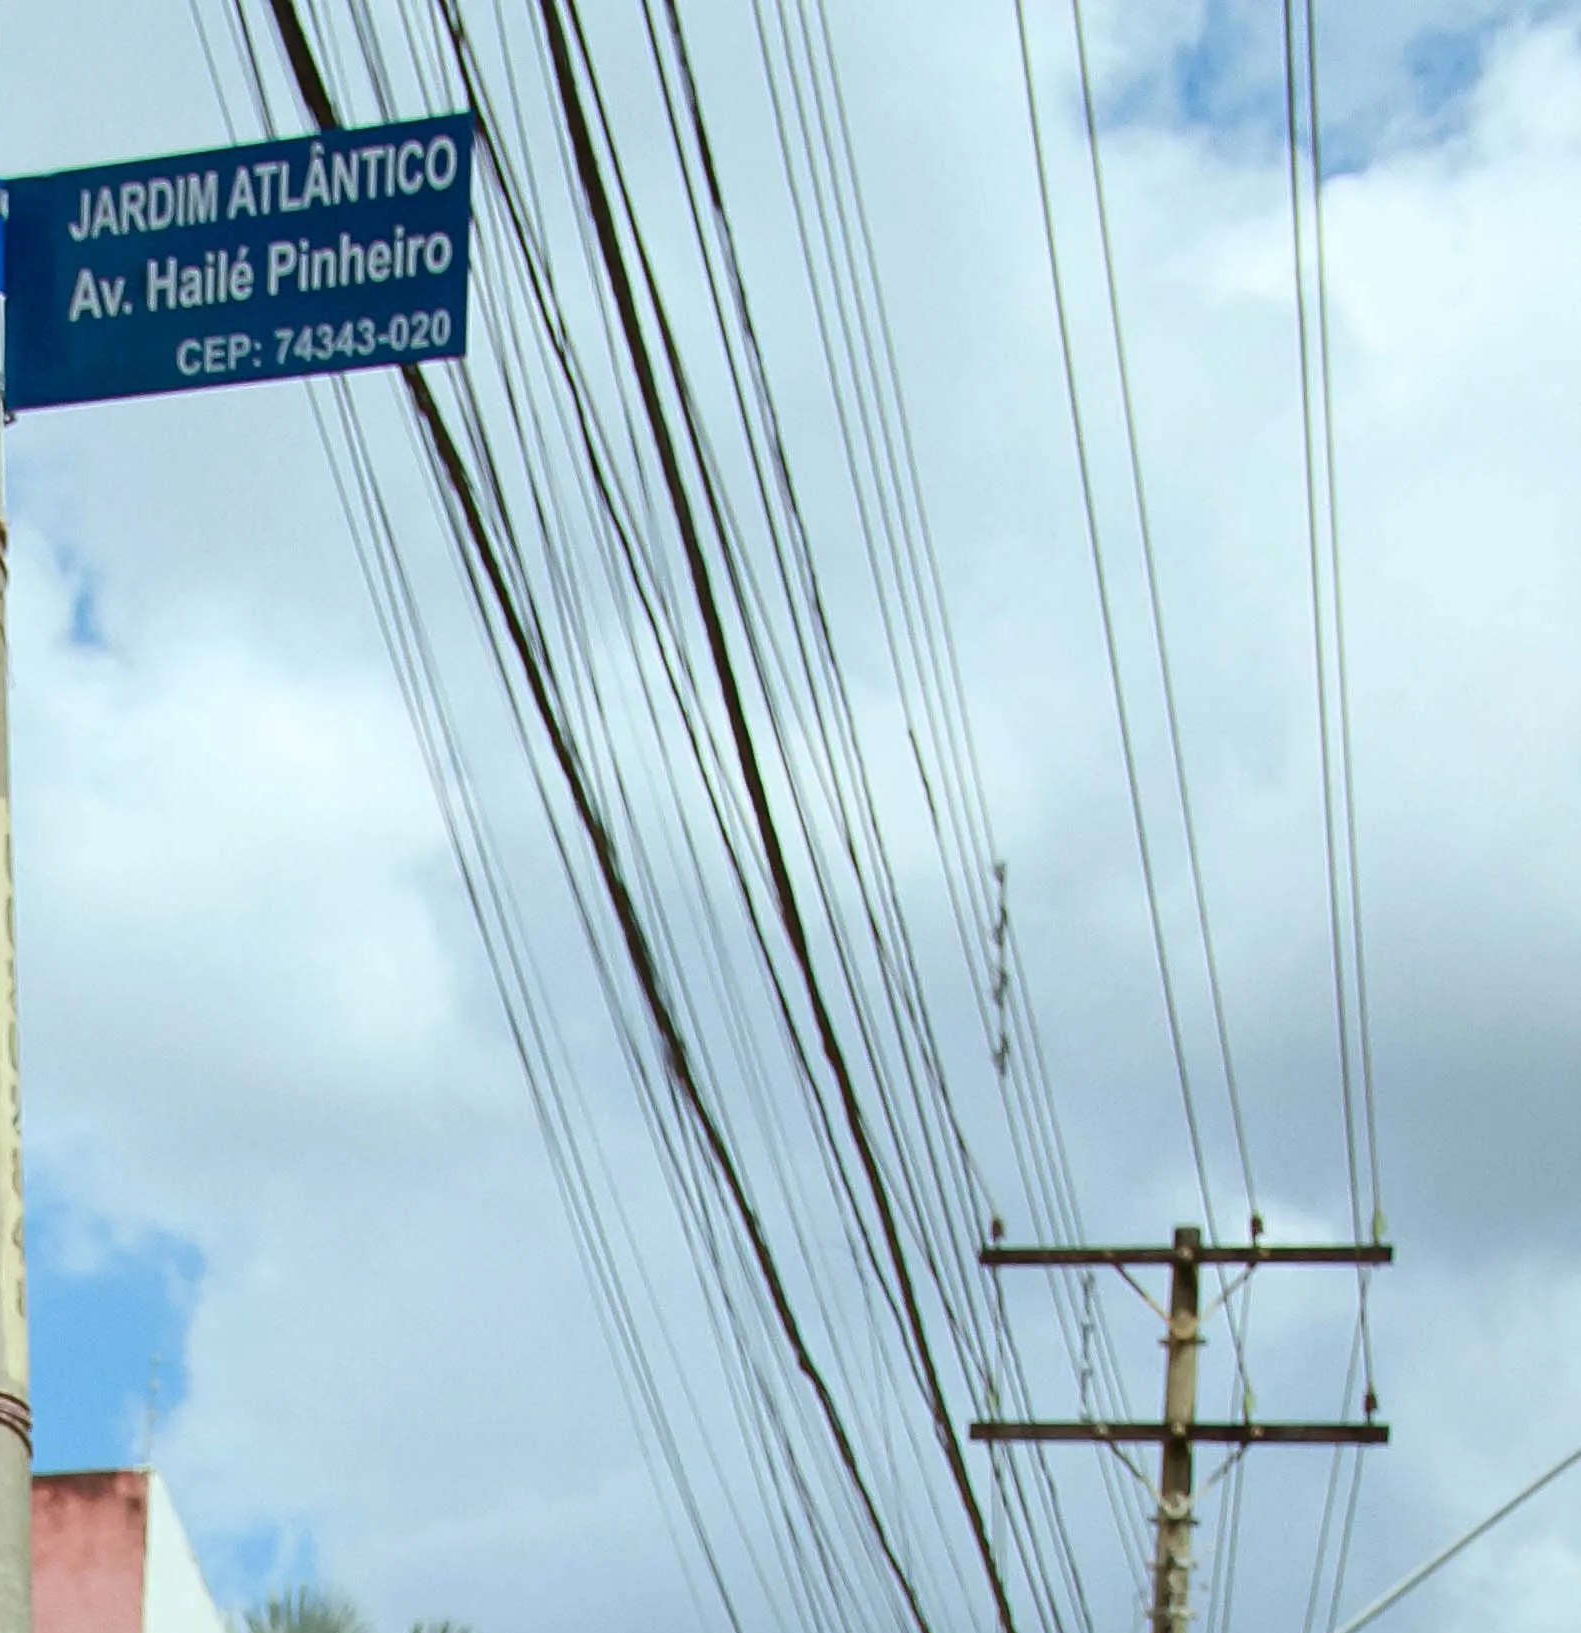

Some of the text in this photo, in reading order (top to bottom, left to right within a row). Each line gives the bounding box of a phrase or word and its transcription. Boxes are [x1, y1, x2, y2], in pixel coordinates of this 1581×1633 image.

[68, 135, 458, 243] JARDIM ATLÂNTICO
[68, 225, 454, 322] Av. Hailé Pinheiro
[175, 309, 453, 376] CEP: 74343-020
